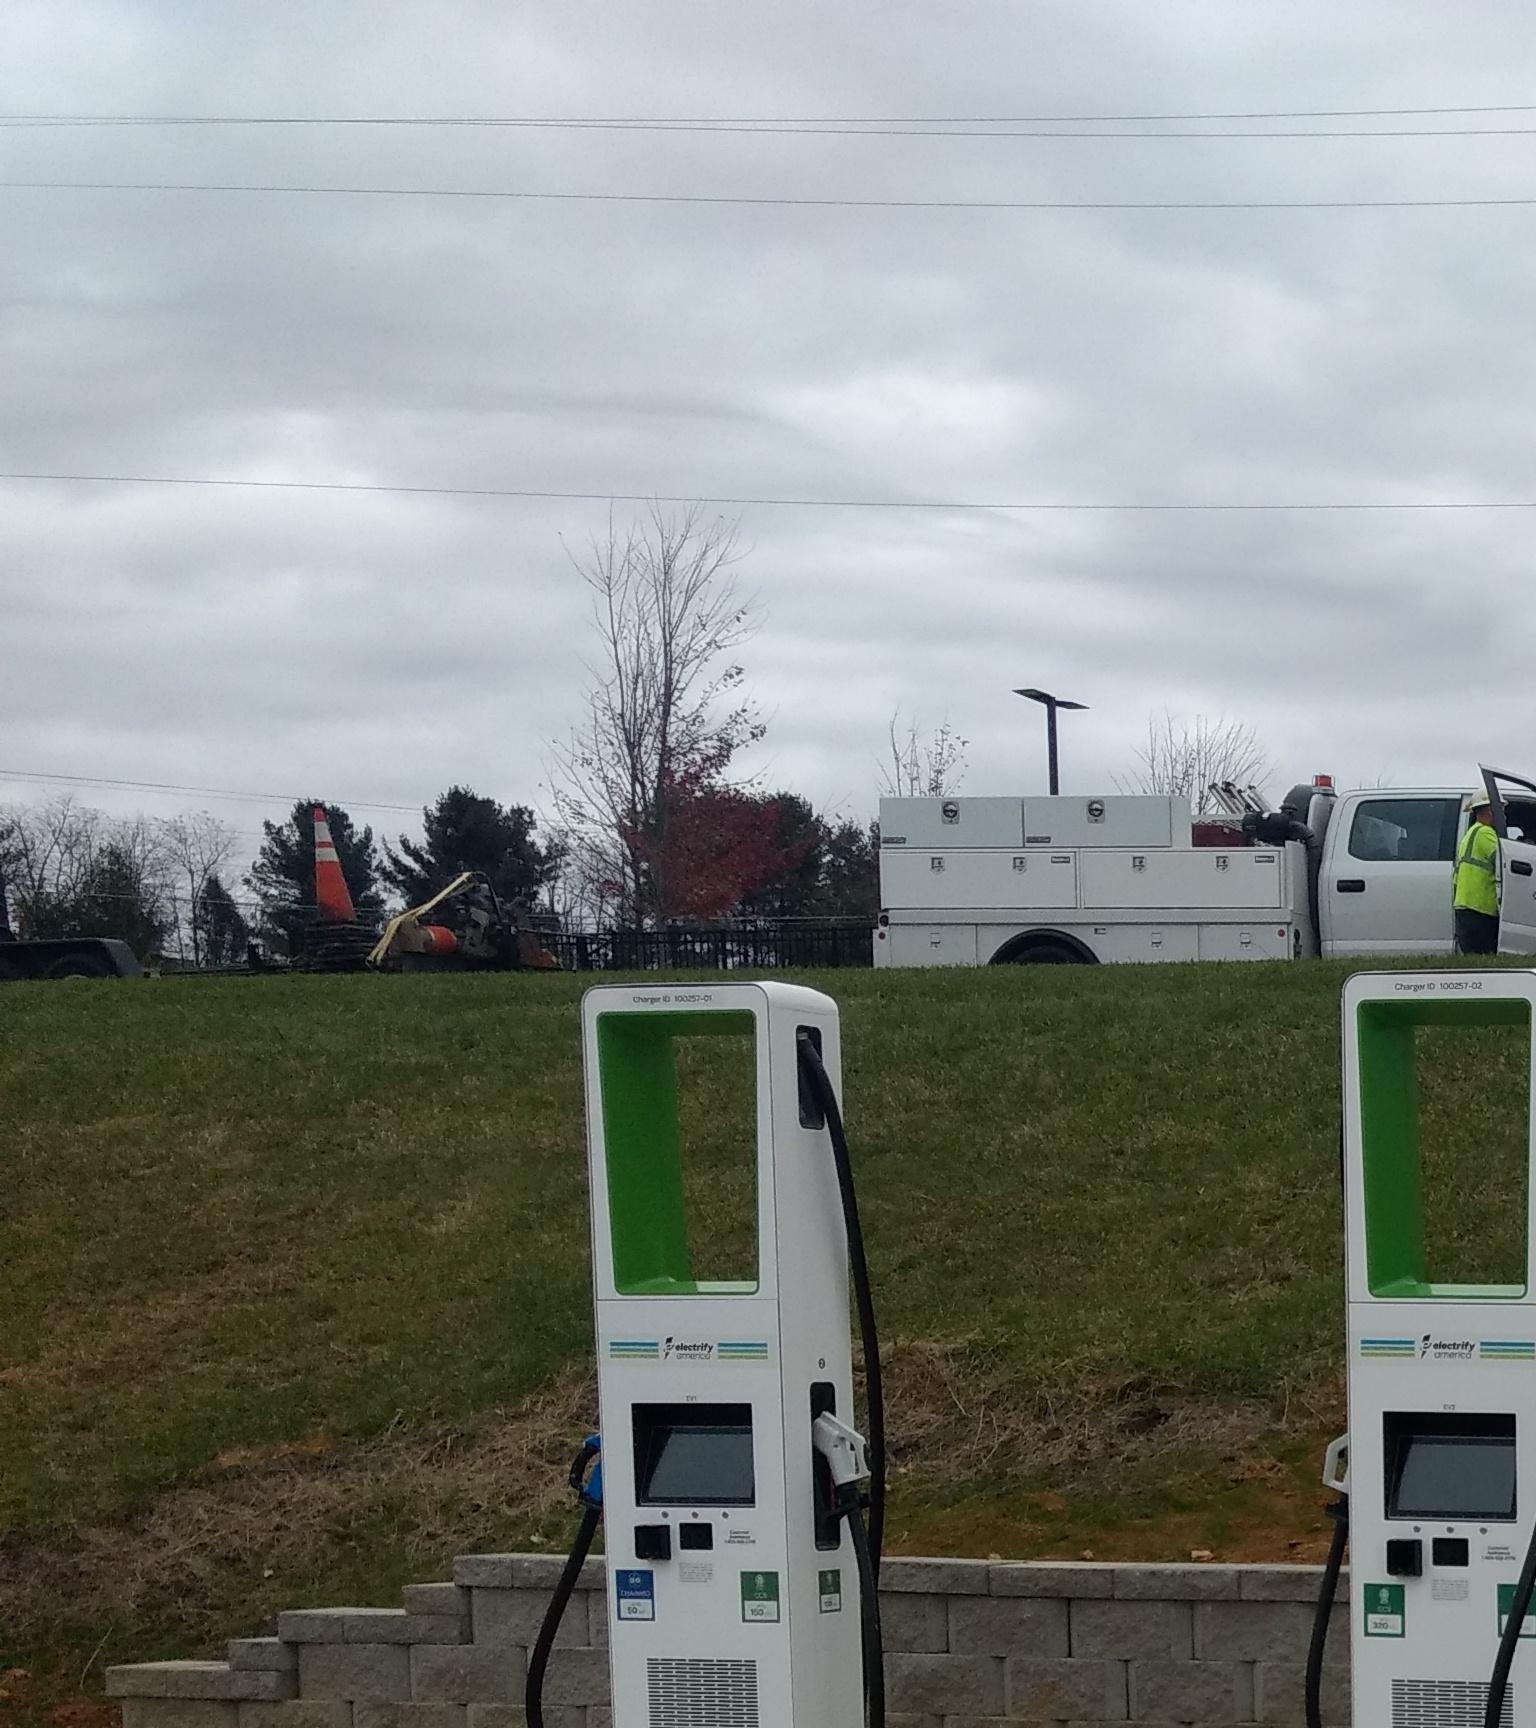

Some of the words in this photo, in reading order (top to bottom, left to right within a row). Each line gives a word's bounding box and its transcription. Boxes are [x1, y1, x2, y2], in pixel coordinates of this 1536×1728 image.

[1394, 982, 1425, 992] Charger
[1427, 982, 1436, 990] ID
[1440, 981, 1483, 990] 100257-02
[675, 1342, 714, 1354] electrify
[1432, 1341, 1476, 1352] electrify
[1434, 1351, 1472, 1360] america
